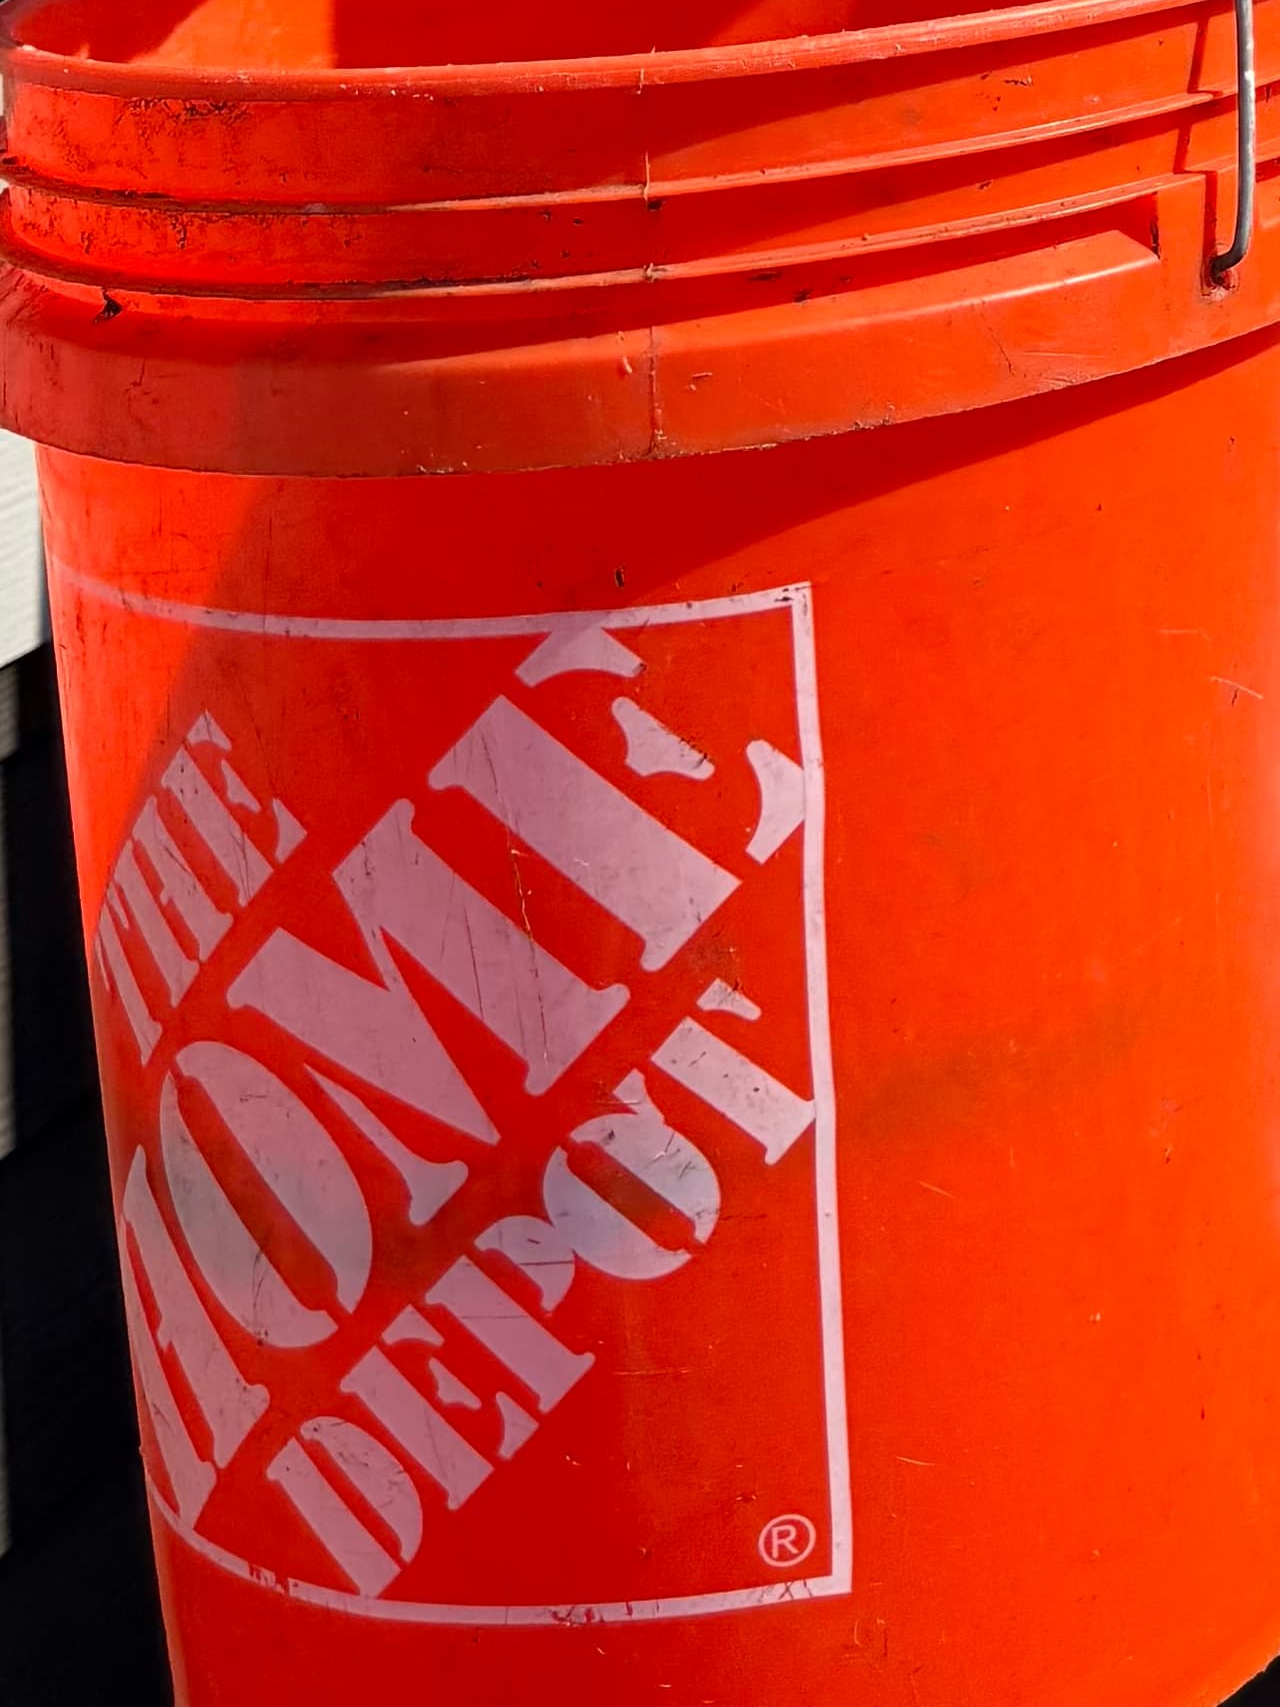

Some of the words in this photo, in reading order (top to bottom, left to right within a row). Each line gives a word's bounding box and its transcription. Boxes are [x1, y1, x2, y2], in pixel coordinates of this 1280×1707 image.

[94, 709, 308, 1067] THE
[122, 624, 806, 1529] HOME
[267, 977, 817, 1599] DEPOT
